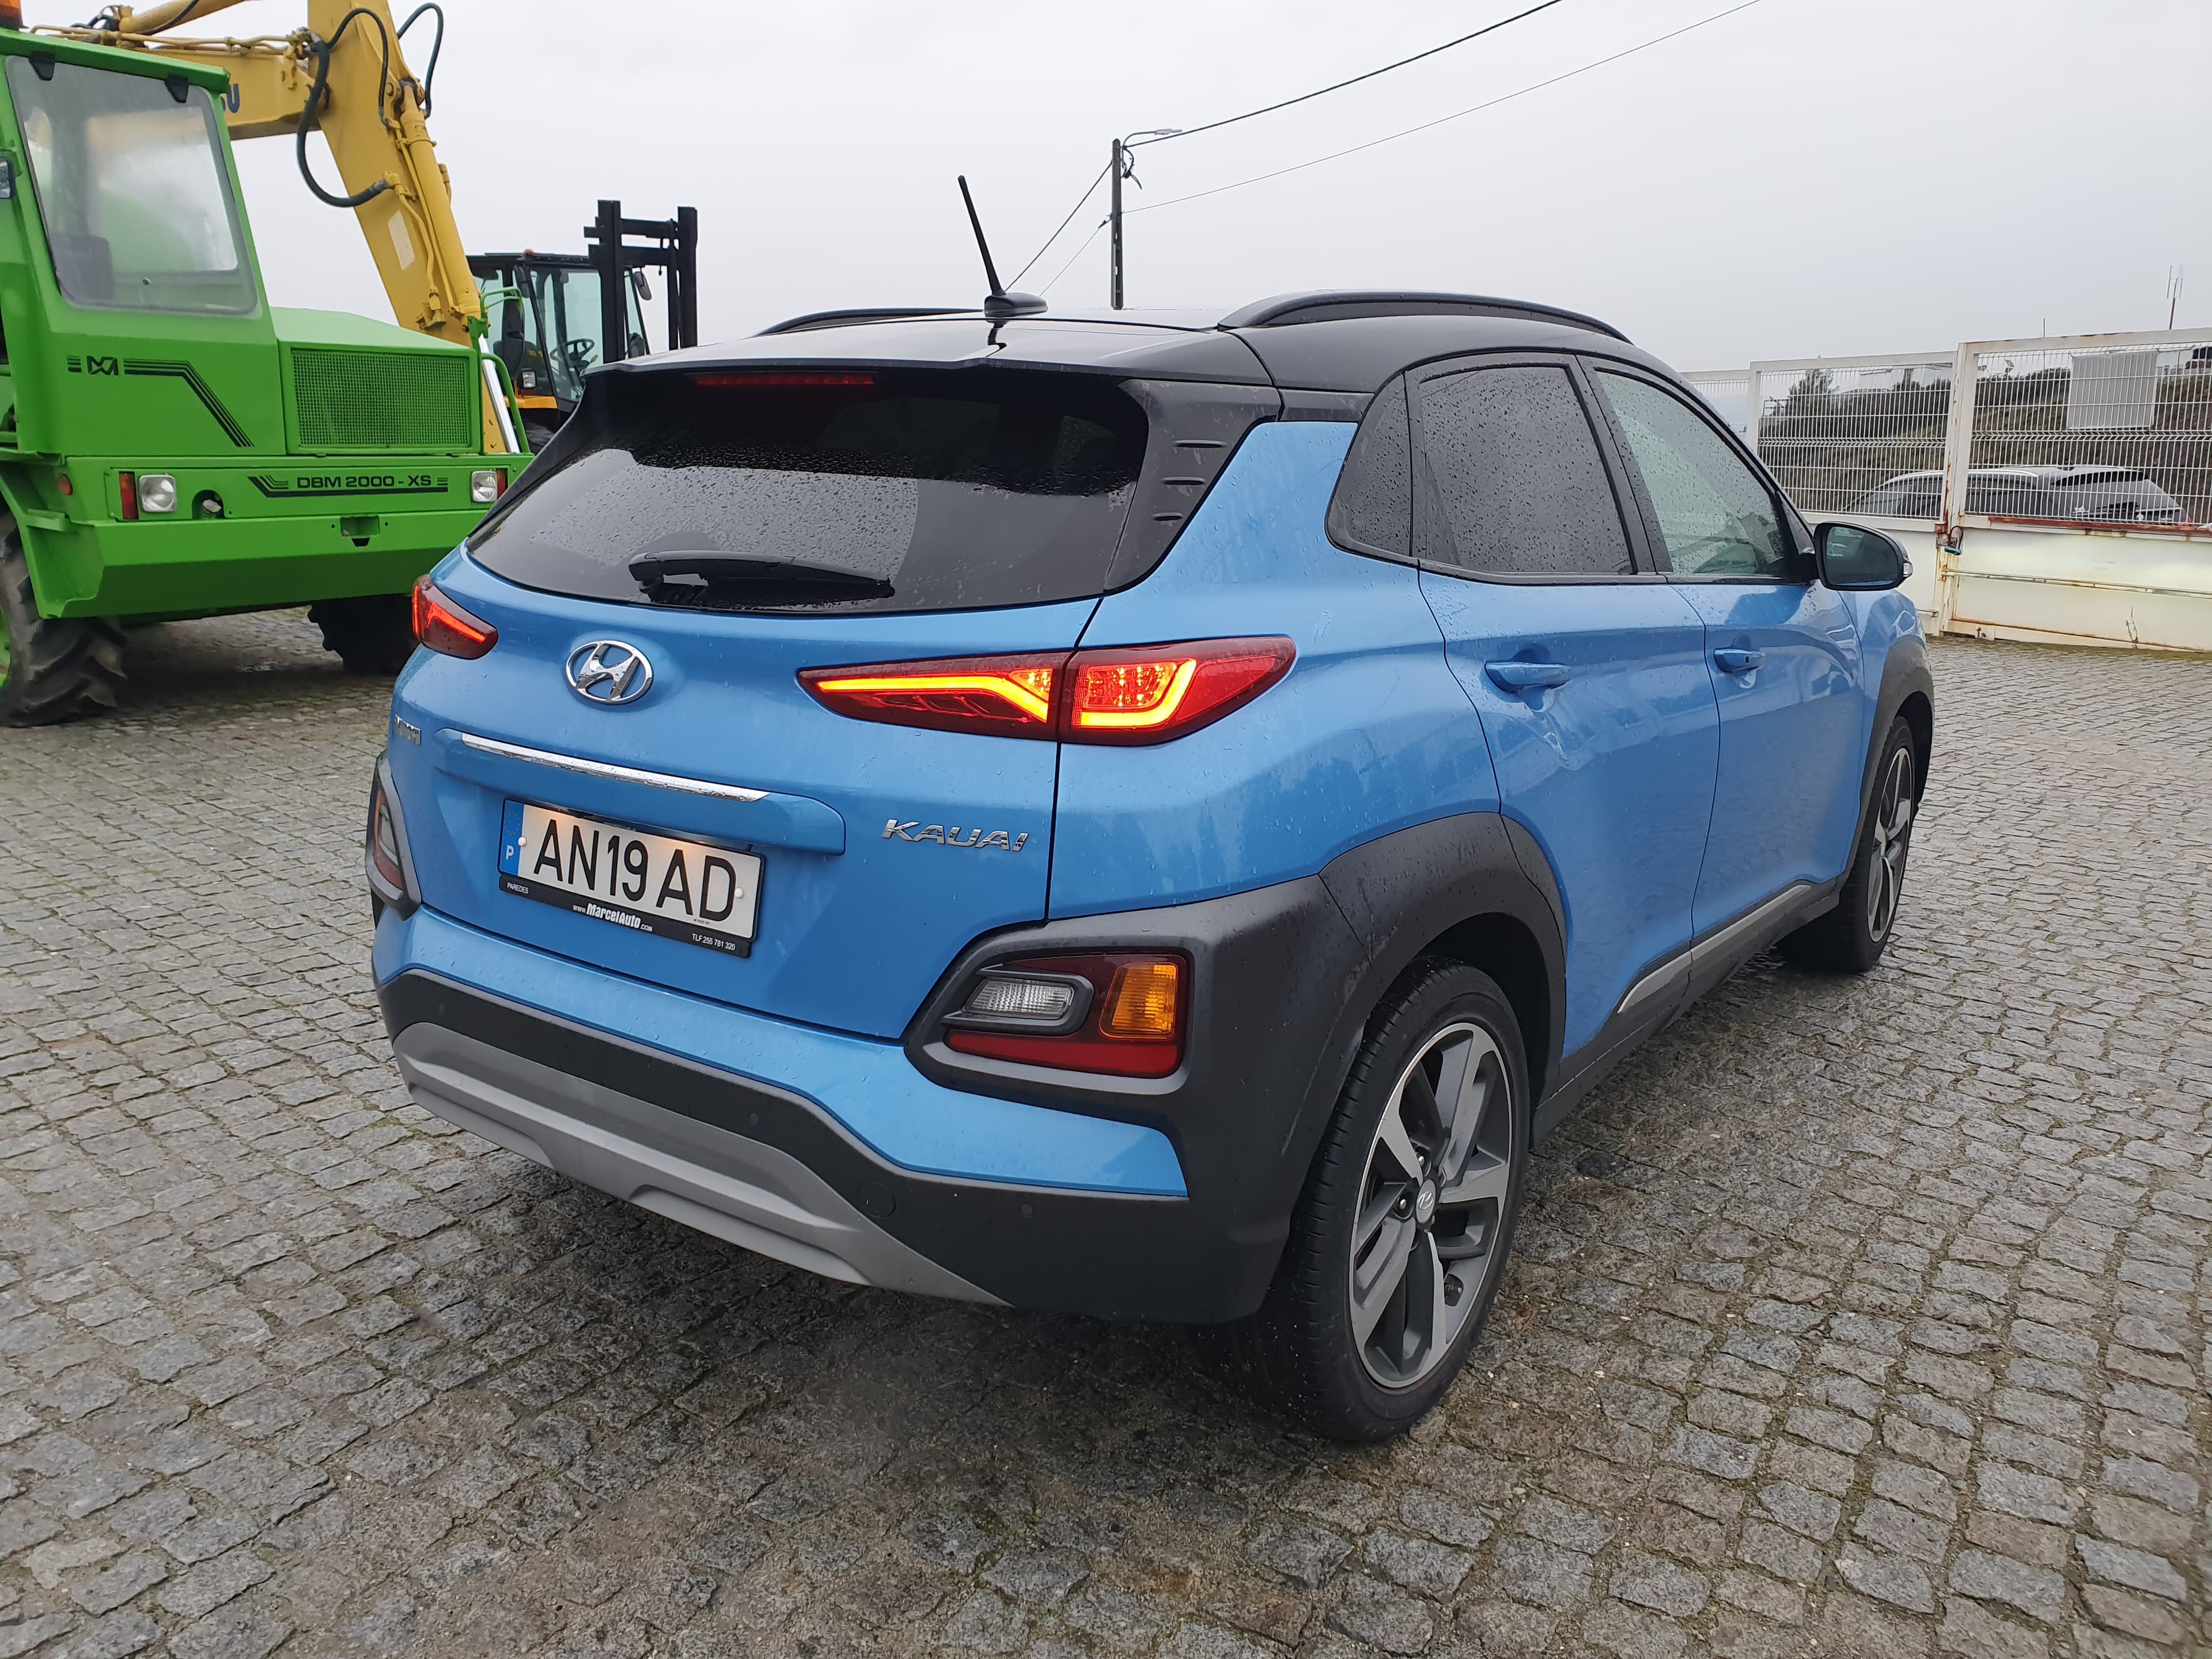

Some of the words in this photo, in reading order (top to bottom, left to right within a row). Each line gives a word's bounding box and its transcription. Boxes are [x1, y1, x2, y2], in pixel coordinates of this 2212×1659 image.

[297, 477, 342, 488] DBM
[346, 476, 395, 487] 2000
[881, 819, 1029, 851] KAUAI
[506, 845, 514, 861] P
[507, 882, 529, 894] PAREDES
[714, 939, 724, 948] 781
[725, 942, 736, 951] 320
